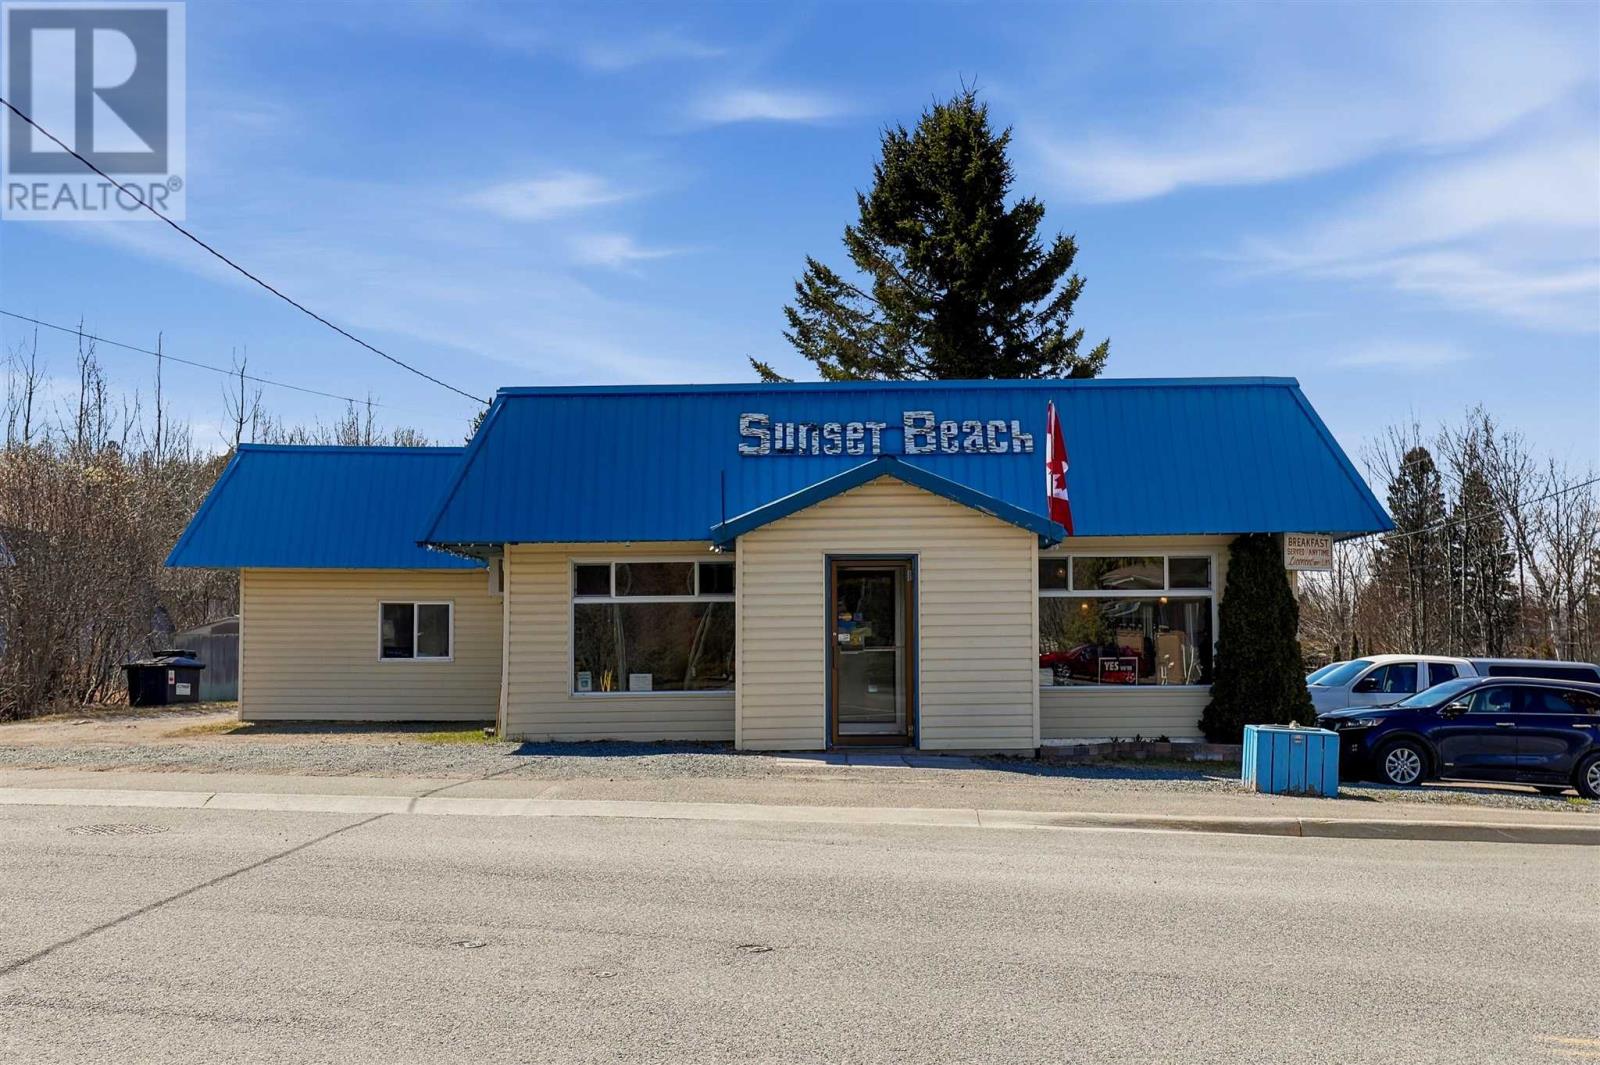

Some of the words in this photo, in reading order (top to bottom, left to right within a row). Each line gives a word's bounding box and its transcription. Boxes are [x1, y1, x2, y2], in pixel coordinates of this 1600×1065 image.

[903, 410, 1034, 455] Beach
[1288, 537, 1328, 548] BREAKFAST
[1104, 661, 1119, 671] YES
